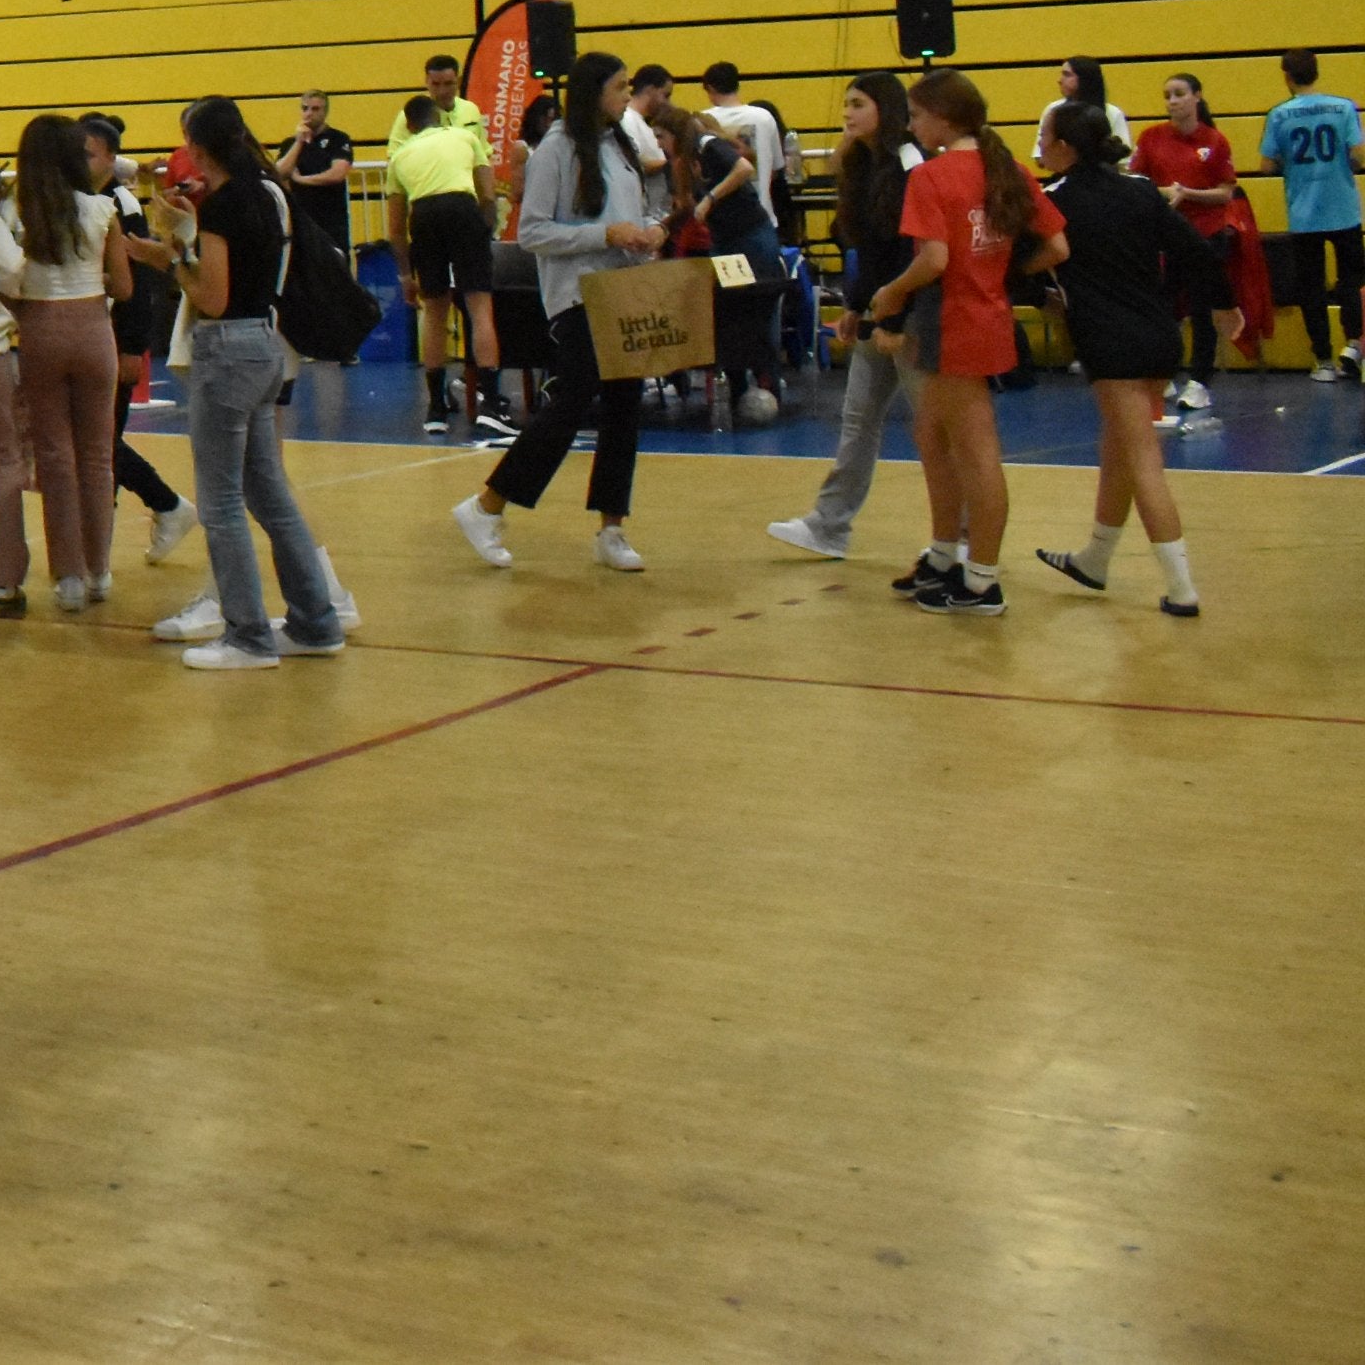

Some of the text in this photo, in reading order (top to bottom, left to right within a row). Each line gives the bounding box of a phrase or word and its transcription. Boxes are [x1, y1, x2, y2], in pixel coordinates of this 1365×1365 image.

[491, 39, 516, 166] BALONMANO
[1289, 123, 1336, 165] 20
[619, 311, 670, 336] little
[622, 329, 690, 353] details
